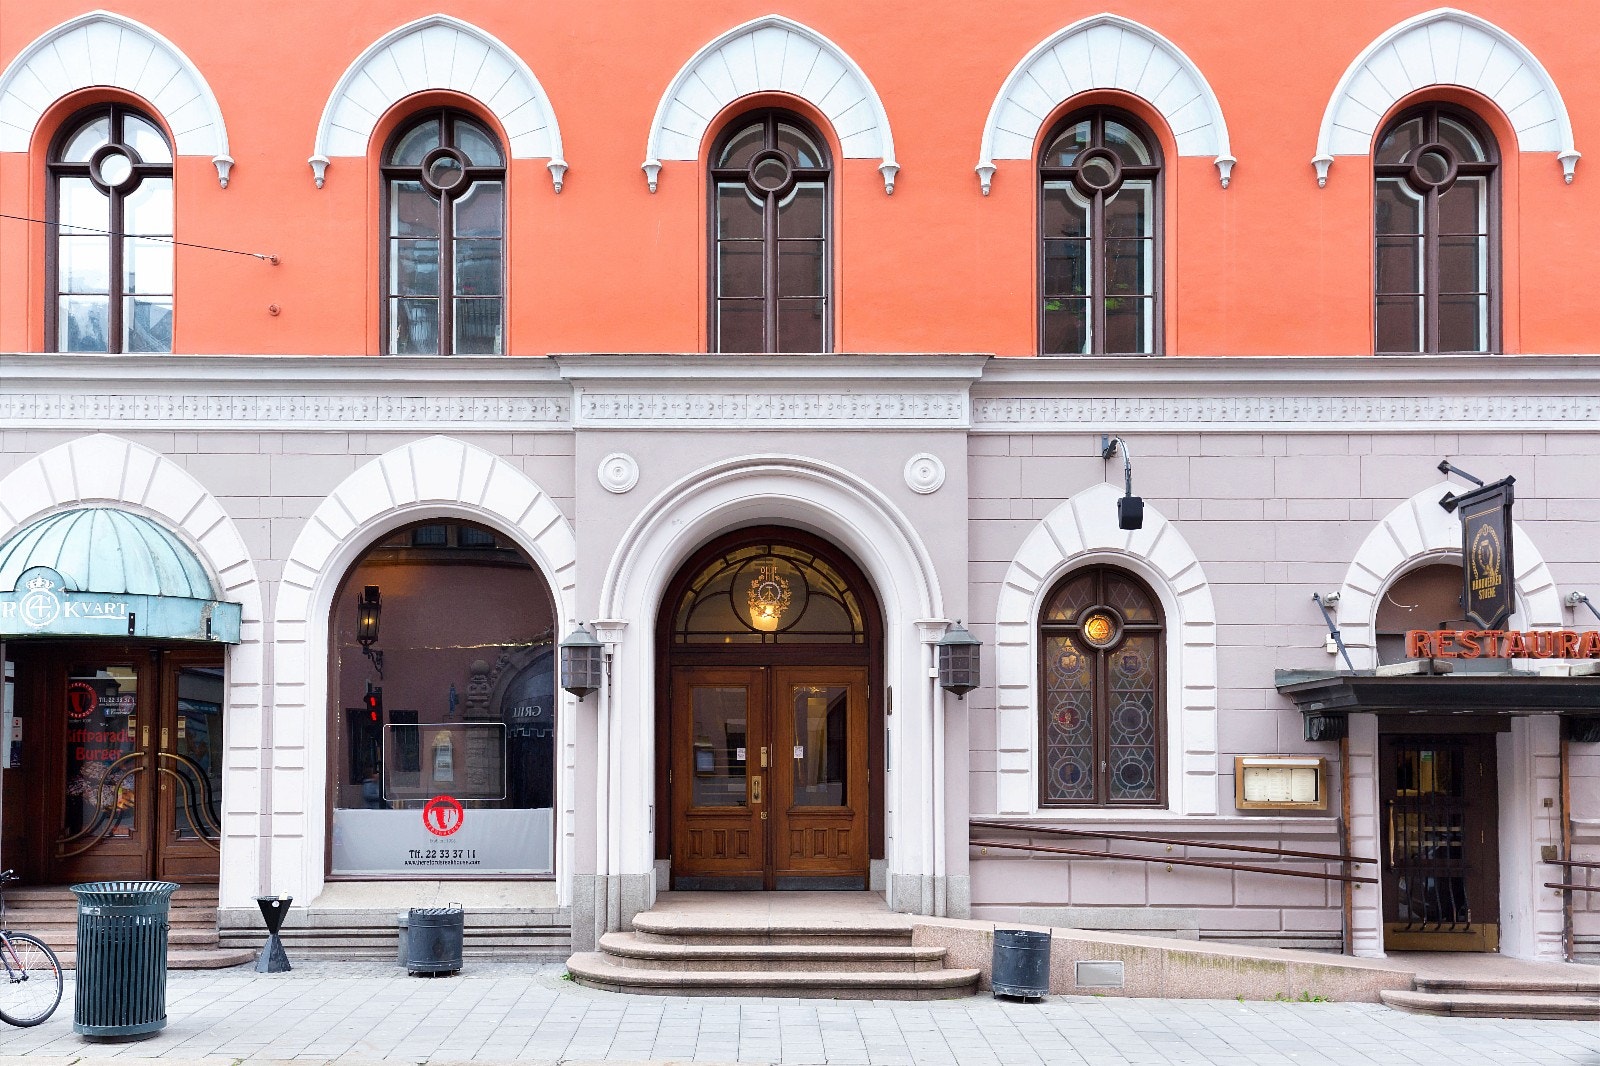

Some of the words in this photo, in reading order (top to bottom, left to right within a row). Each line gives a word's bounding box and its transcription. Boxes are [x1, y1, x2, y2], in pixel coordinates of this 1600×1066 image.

[1407, 630, 1600, 659] RESTAURA
[409, 849, 423, 859] Tlf.
[425, 849, 437, 859] 22
[439, 849, 450, 859] 33
[452, 849, 463, 859] 37
